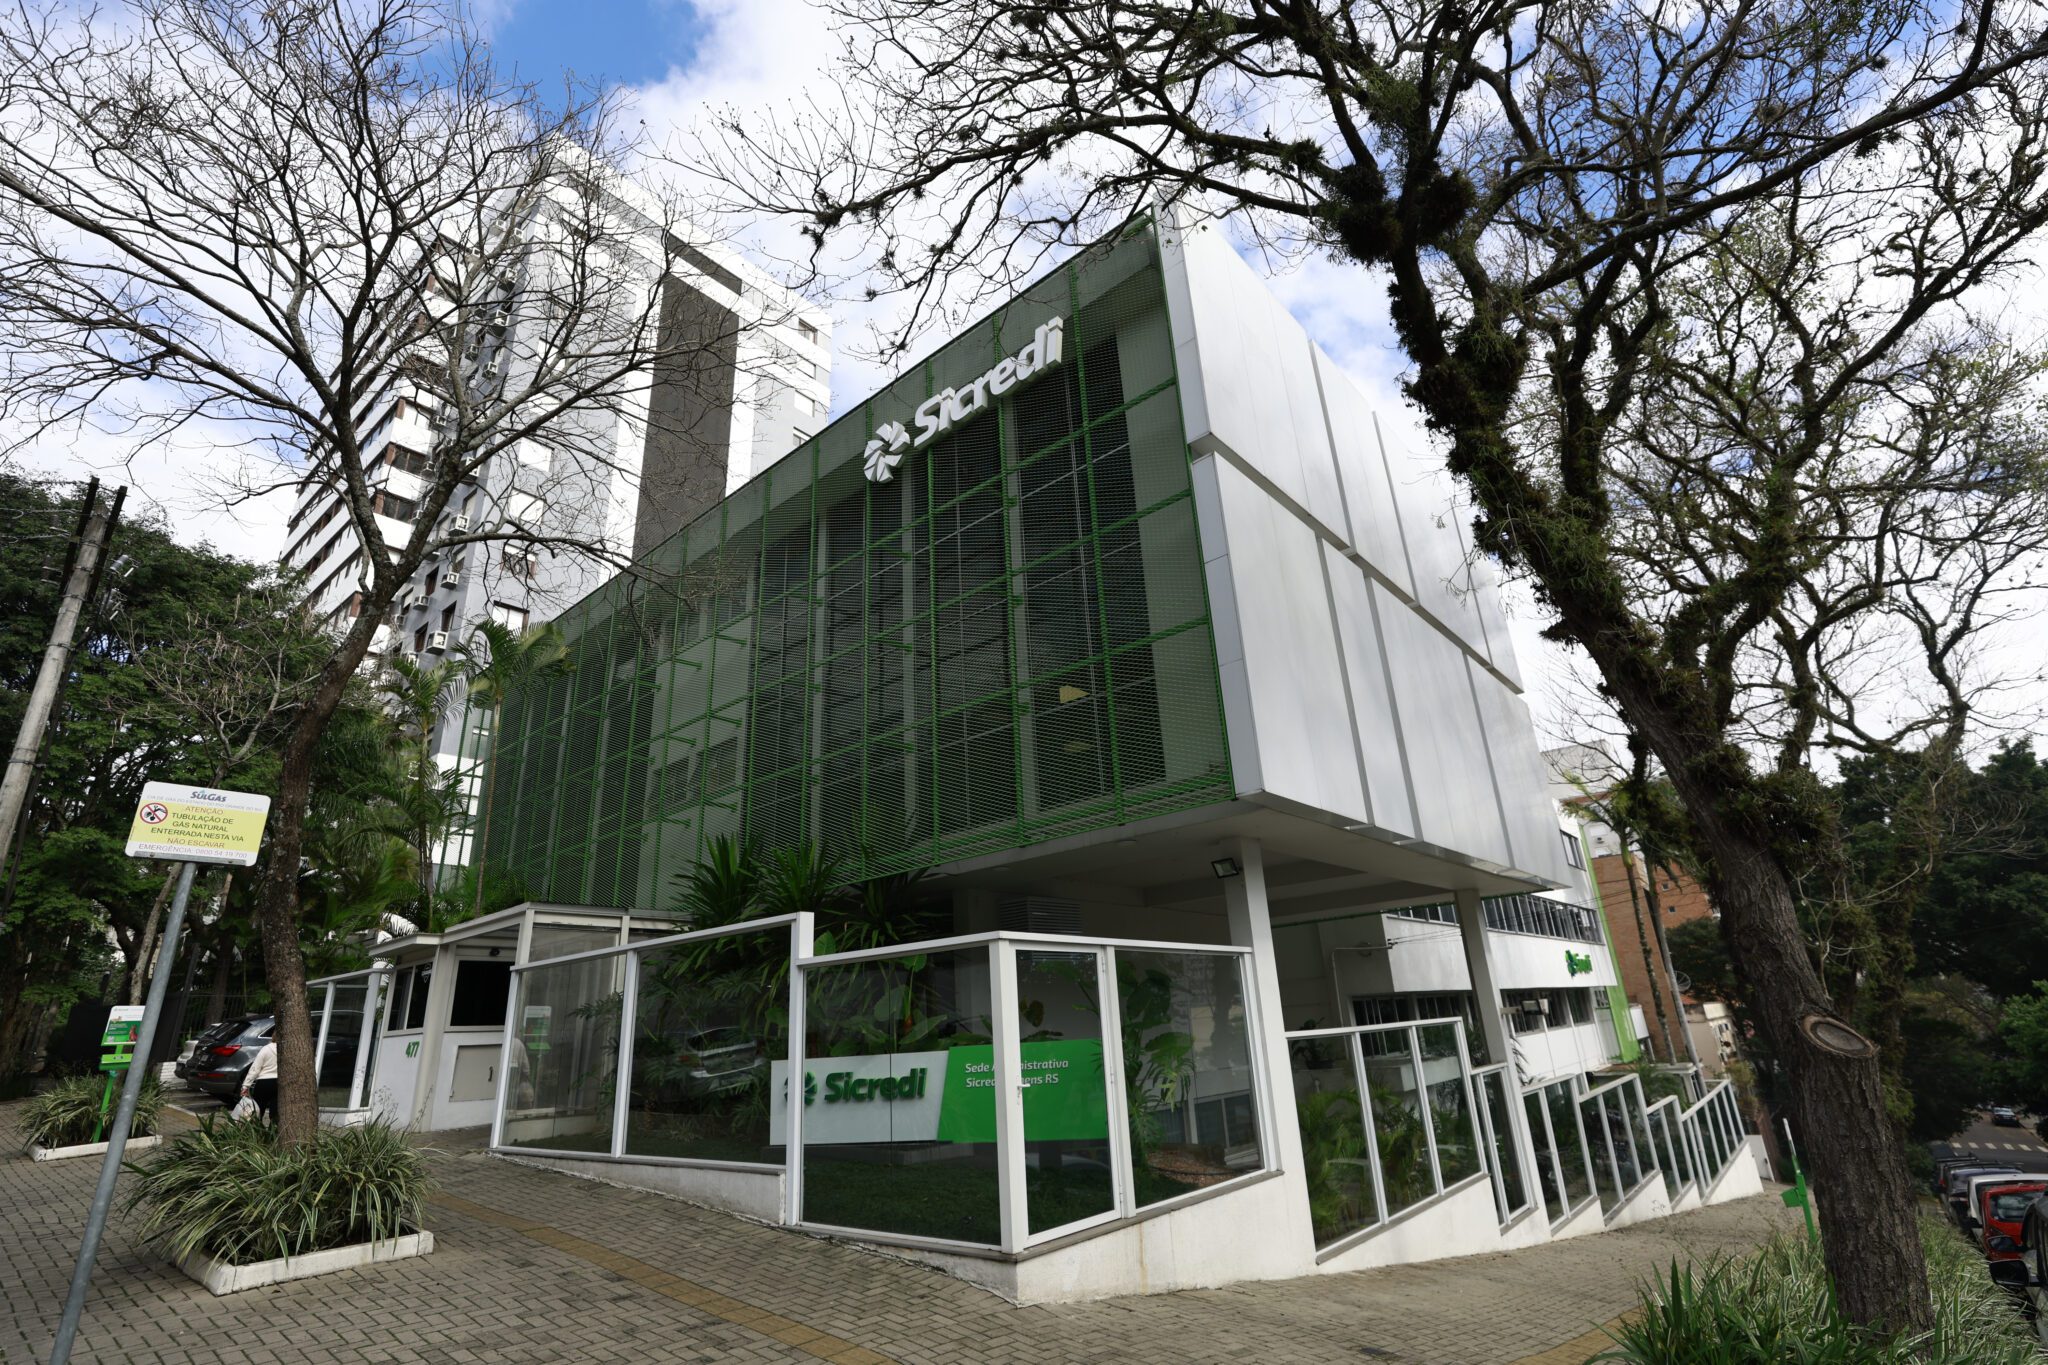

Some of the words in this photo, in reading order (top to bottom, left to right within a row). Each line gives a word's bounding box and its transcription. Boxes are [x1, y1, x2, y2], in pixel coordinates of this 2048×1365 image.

[914, 316, 1063, 447] Sicredi
[184, 805, 224, 815] ATENÇÃO
[172, 812, 221, 824] TUBULAÇÃO
[191, 823, 228, 832] NATURAL
[151, 827, 203, 838] ENTERRADA
[203, 832, 230, 840] NESTA
[166, 837, 186, 845] NÃO
[187, 840, 225, 848] ESCAVAR
[405, 1041, 420, 1058] 477
[965, 1062, 989, 1073] Sede
[1045, 1073, 1059, 1084] RS
[824, 1068, 927, 1103] Sicredi
